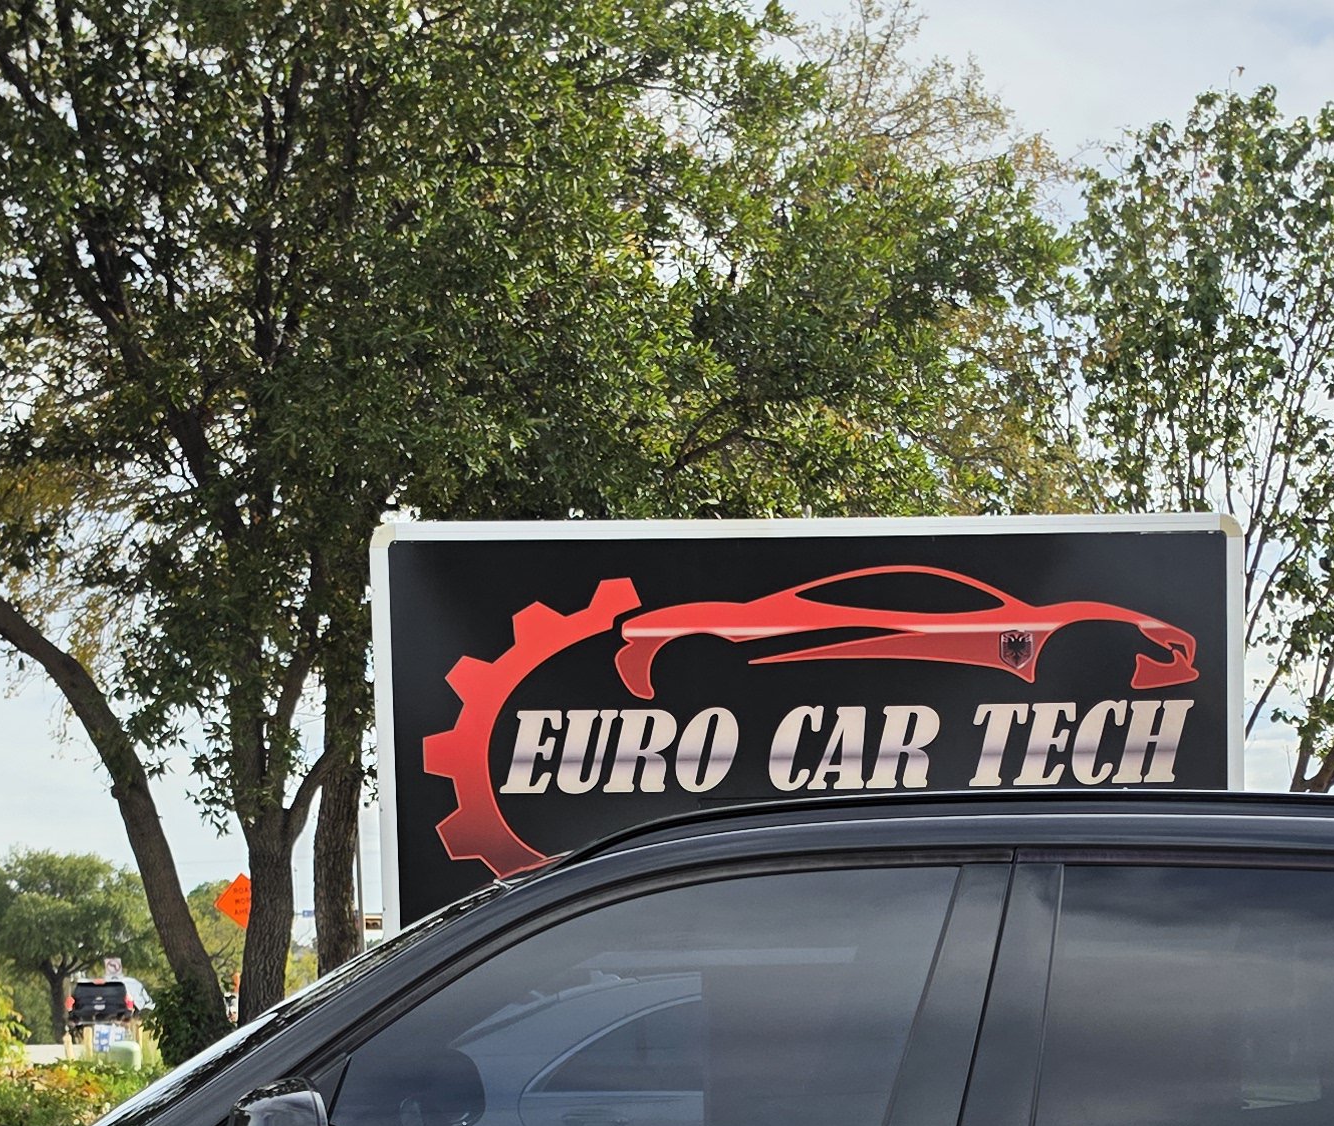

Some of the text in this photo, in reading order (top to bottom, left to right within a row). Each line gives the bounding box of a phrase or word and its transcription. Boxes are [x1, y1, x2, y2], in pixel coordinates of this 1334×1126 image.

[499, 699, 1195, 795] EURO CAR TECH
